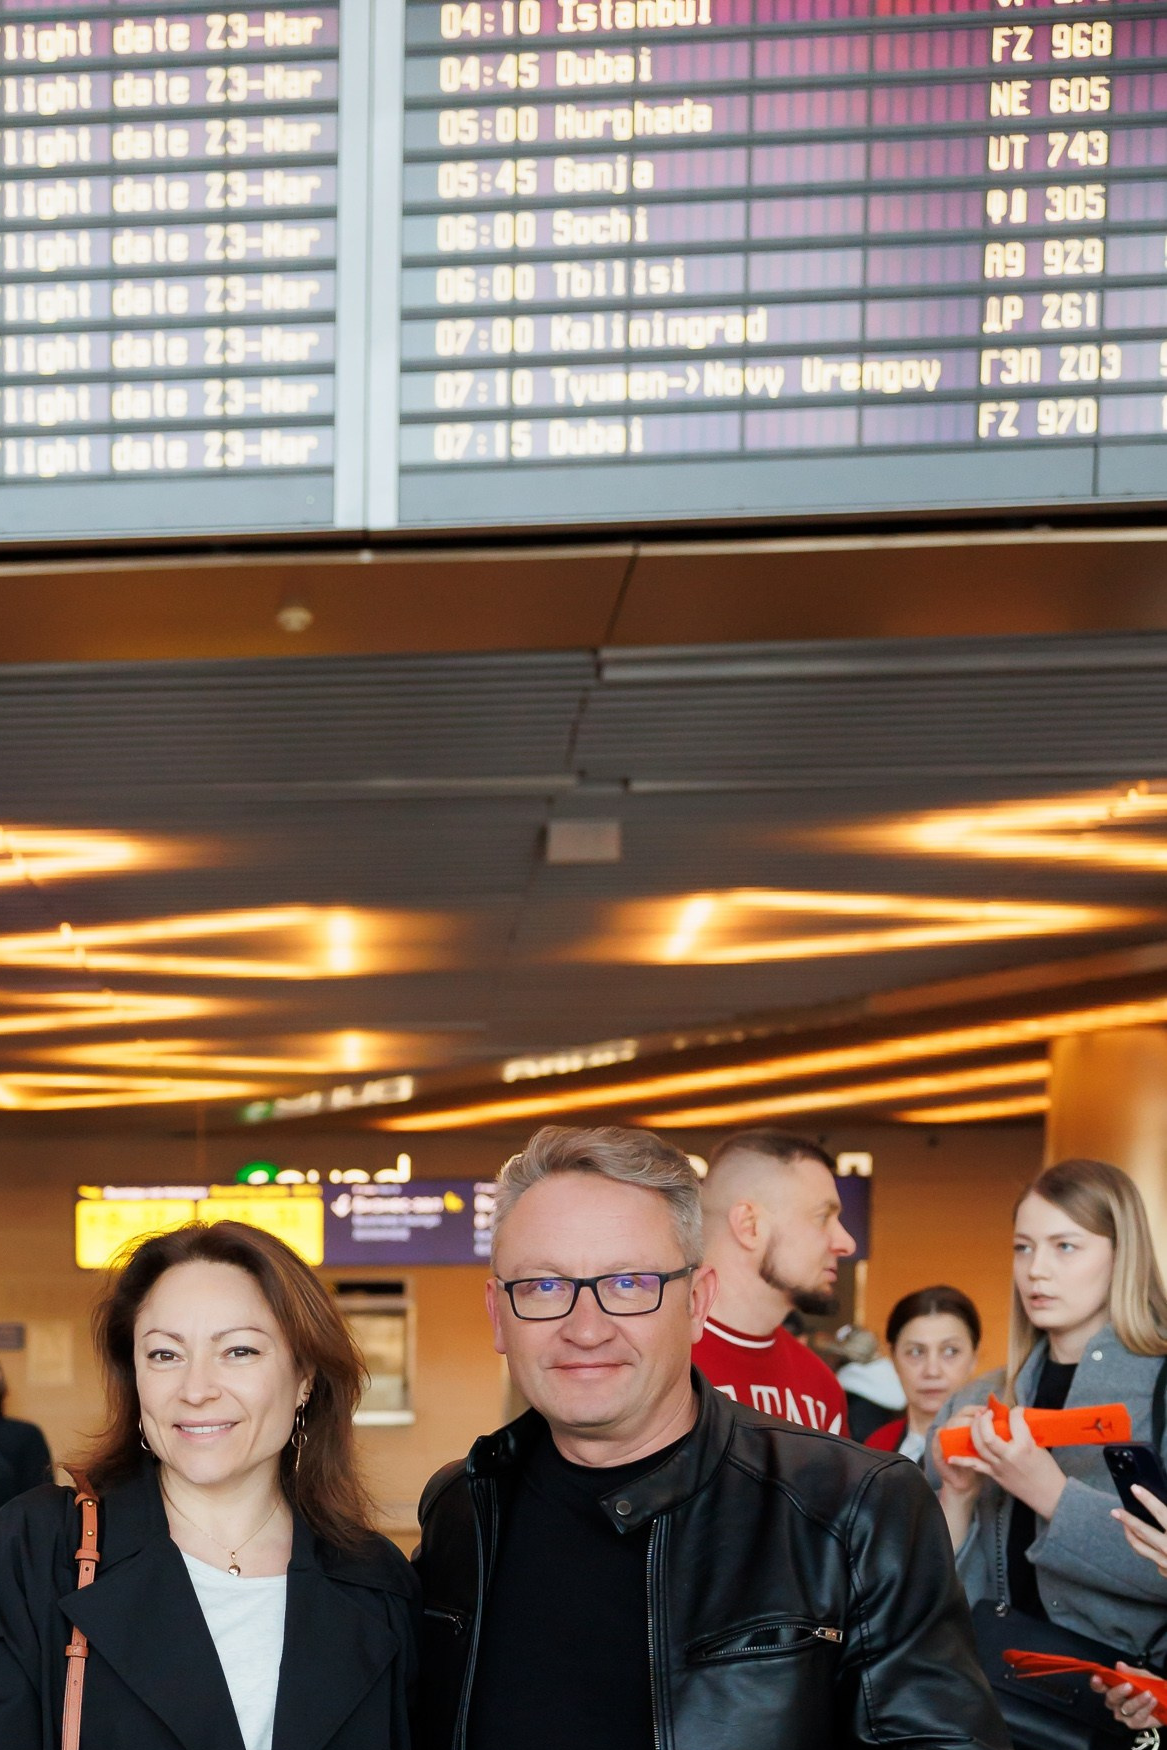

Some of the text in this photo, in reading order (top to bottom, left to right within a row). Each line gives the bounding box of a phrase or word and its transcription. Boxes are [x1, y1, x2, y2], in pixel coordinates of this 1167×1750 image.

[113, 18, 190, 55] date
[205, 11, 323, 50] 23-Mar
[440, 0, 712, 39] 04:10 Istanbul
[439, 21, 1112, 93] 04:45 Dubai FZ 968
[113, 70, 190, 108] date
[205, 65, 323, 103] 23-Mar
[438, 106, 539, 146] 05:00
[990, 80, 1031, 117] NE
[1049, 76, 1110, 114] 605
[112, 123, 190, 160] date
[204, 117, 322, 156] 23-Mar
[437, 130, 1108, 199] 05:45 Ganja UT 743
[112, 176, 190, 213] date
[204, 170, 322, 209] 23-Mar
[436, 212, 537, 252] 06:00
[551, 206, 649, 247] Sochi
[1044, 184, 1106, 222] 305
[112, 228, 190, 265] date
[204, 222, 321, 261] 23-Mar
[435, 238, 1104, 304] 06:00 Tbilisi A9 929
[112, 280, 189, 317] date
[204, 274, 321, 313] 23-Mar
[434, 317, 535, 357] 07:00
[550, 306, 769, 352] Kaliningrad
[1041, 292, 1097, 330] 261
[112, 331, 189, 368] date
[203, 326, 320, 365] 23-Mar
[433, 369, 535, 409] 07:10
[801, 357, 941, 394] Urengoy
[1058, 344, 1122, 382] 203
[111, 382, 189, 420] date
[202, 378, 320, 416] 23-Mar
[112, 434, 189, 471] date
[202, 430, 320, 468] 23-Mar
[431, 398, 1097, 461] 07:15 Dubai FZ 970
